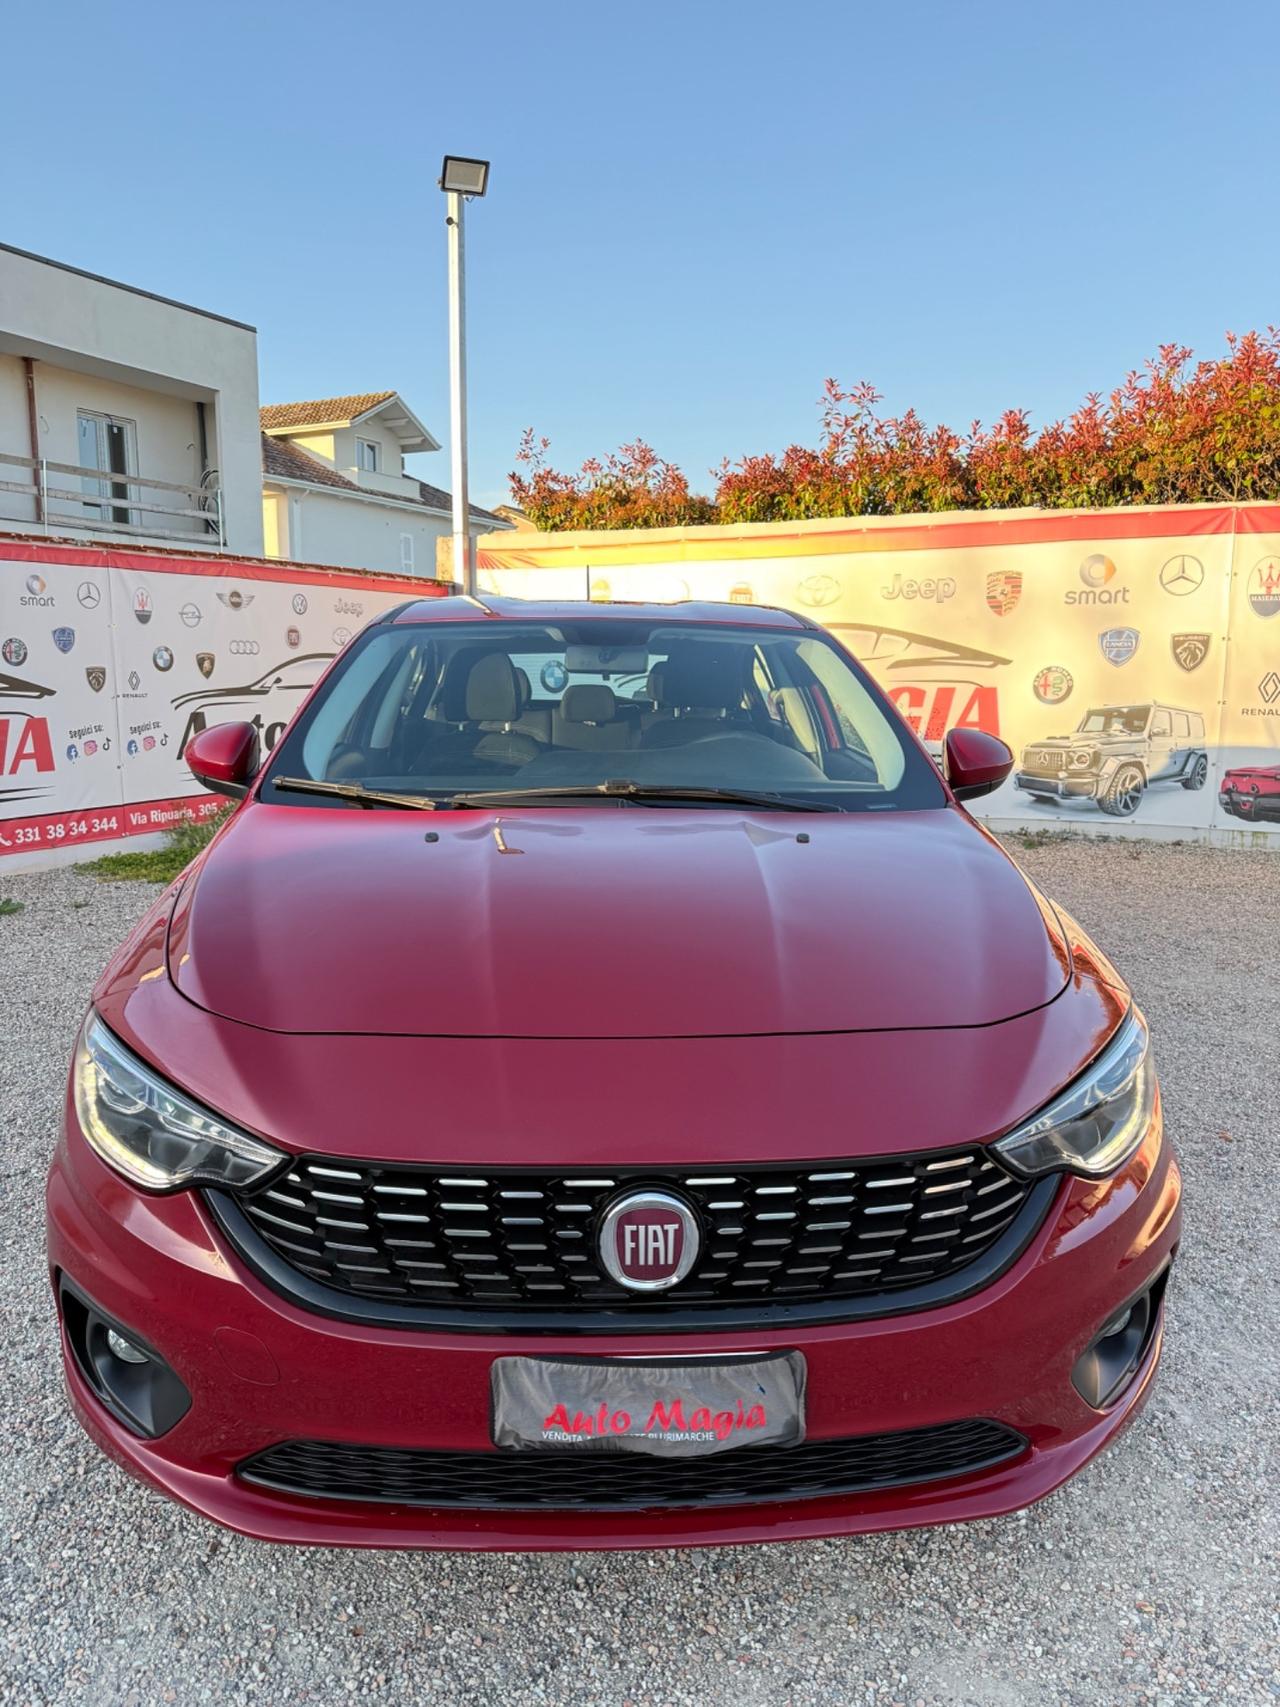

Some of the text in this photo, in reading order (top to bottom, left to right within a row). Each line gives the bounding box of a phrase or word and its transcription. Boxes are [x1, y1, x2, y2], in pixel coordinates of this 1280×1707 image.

[20, 596, 55, 607] smart
[880, 573, 957, 603] Jeep
[1064, 586, 1130, 605] smart
[130, 812, 148, 826] Via
[197, 802, 218, 816] 305
[15, 816, 118, 844] 331 38 34 344
[624, 1223, 679, 1266] FIAT
[543, 1397, 767, 1441] Auto Magia
